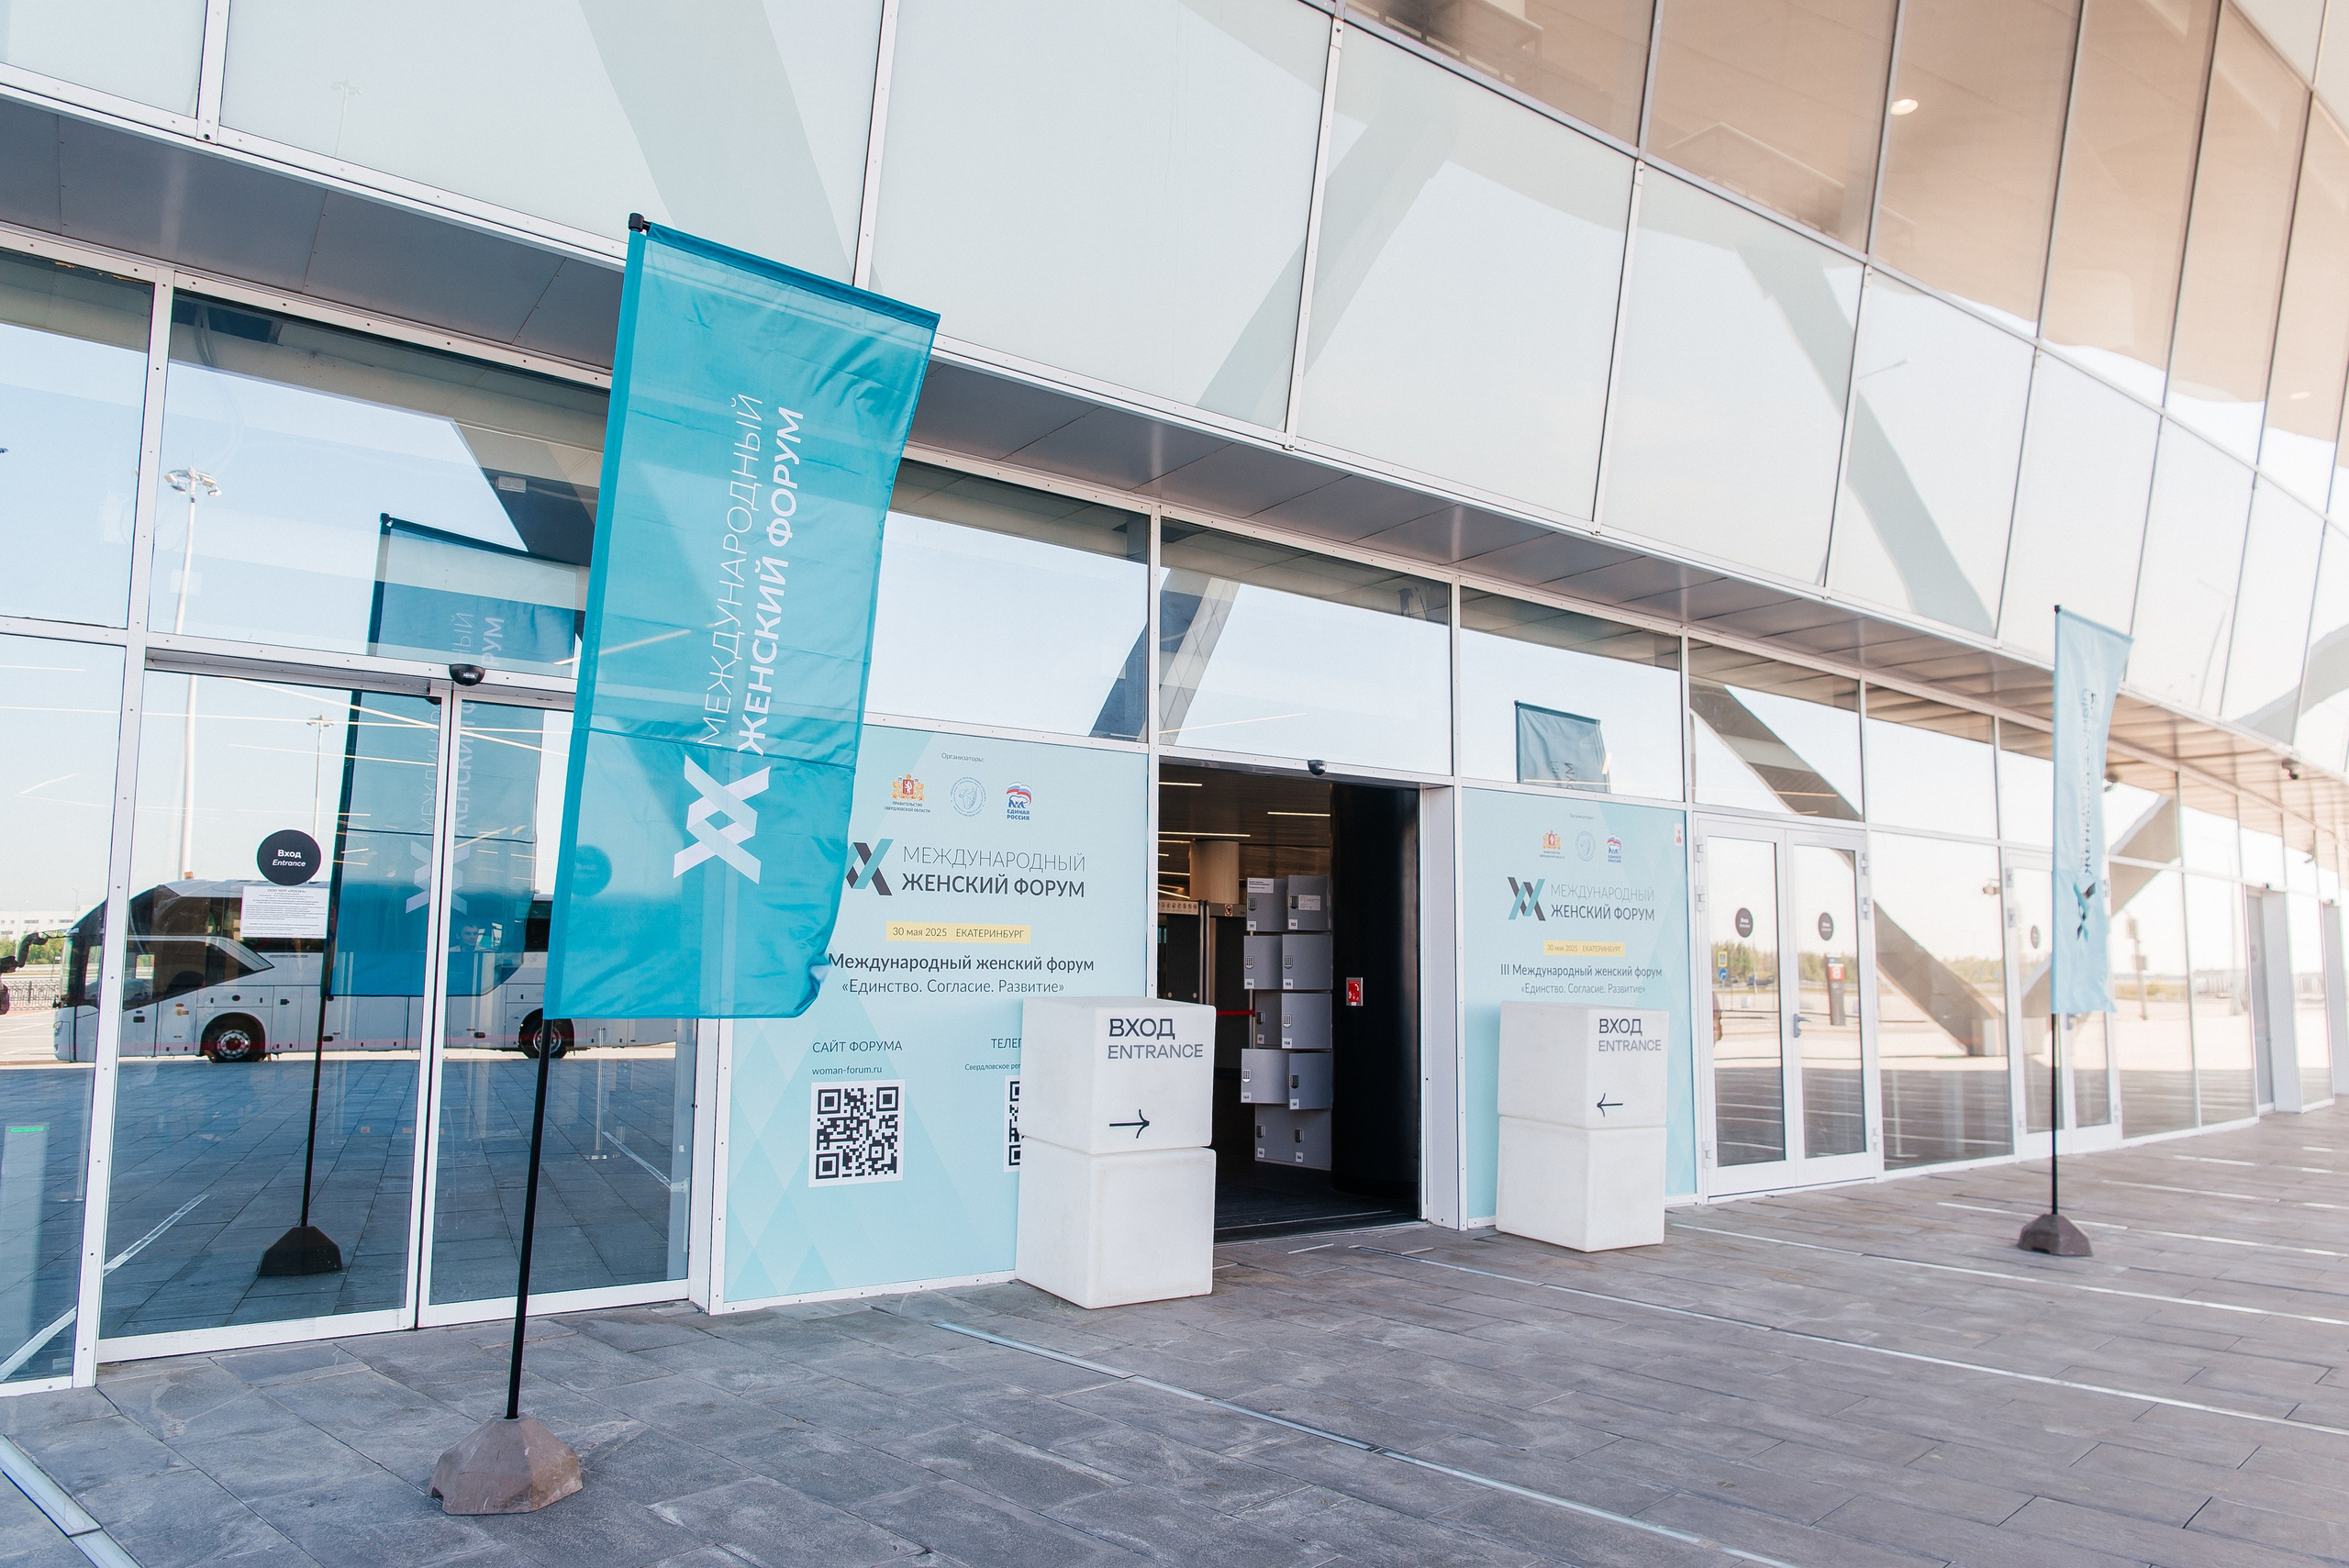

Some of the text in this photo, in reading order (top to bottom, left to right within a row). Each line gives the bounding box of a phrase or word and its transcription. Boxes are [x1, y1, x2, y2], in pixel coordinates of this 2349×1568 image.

[697, 394, 763, 747] МЕЖДУНАРОДНЫЙ
[737, 406, 804, 756] ЖЕНСКИЙ ФОРУМ
[941, 752, 985, 763] Организаторы:
[277, 849, 302, 858] Вход
[903, 845, 1085, 873] МЕЖДУНАРОДНЫЙ
[272, 859, 306, 867] Entrance
[901, 873, 1085, 897] ЖЕНСКИЙ ФОРУМ
[1551, 884, 1654, 902] МЕЖДУНАРОДНЫЙ
[1551, 905, 1654, 921] ЖЕНСКИЙ ФОРУМ
[892, 927, 905, 937] 30
[925, 928, 947, 938] 2025
[956, 929, 1024, 939] ЕКАТЕРИНБУРГ
[828, 952, 1094, 973] Международный женский форум
[1501, 964, 1663, 979] III Международный женский форум
[841, 979, 1064, 995] «Единство. Согласие. Развитие»
[1521, 984, 1645, 995] «Единство. Согласие. Развитие»
[1109, 1018, 1175, 1040] ВХОД
[1599, 1018, 1642, 1036] ВХОД
[812, 1040, 903, 1053] САЙТ ФОРУМА
[991, 1038, 1021, 1049] ТЕЛЕГ
[1598, 1040, 1661, 1051] ENTRANCE
[1108, 1044, 1203, 1059] ENTRANCE
[812, 1065, 883, 1075] woman-forum.ru
[964, 1063, 1009, 1072] Свердловское
